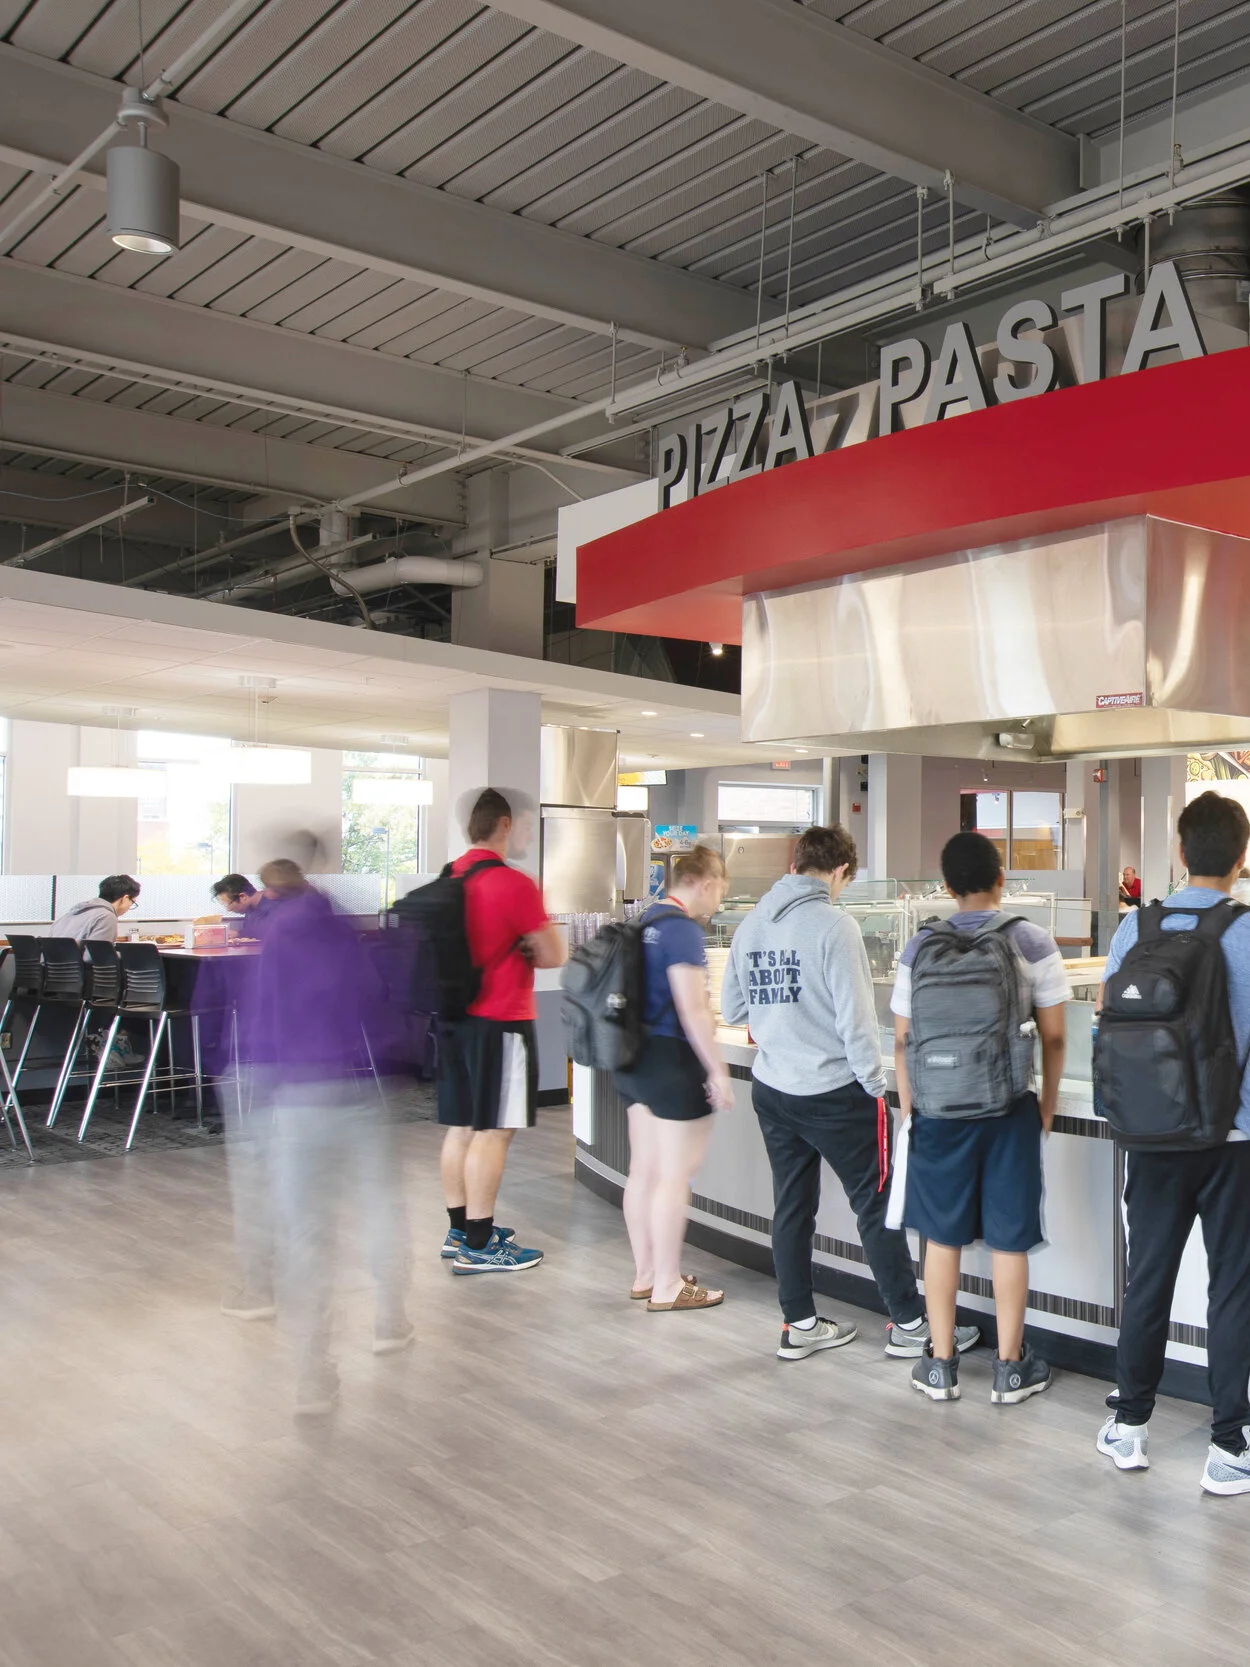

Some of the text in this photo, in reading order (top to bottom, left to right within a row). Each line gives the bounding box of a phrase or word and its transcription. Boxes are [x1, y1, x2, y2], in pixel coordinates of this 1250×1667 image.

[658, 261, 1208, 511] PIZZA PASTA
[747, 950, 777, 968] T'S
